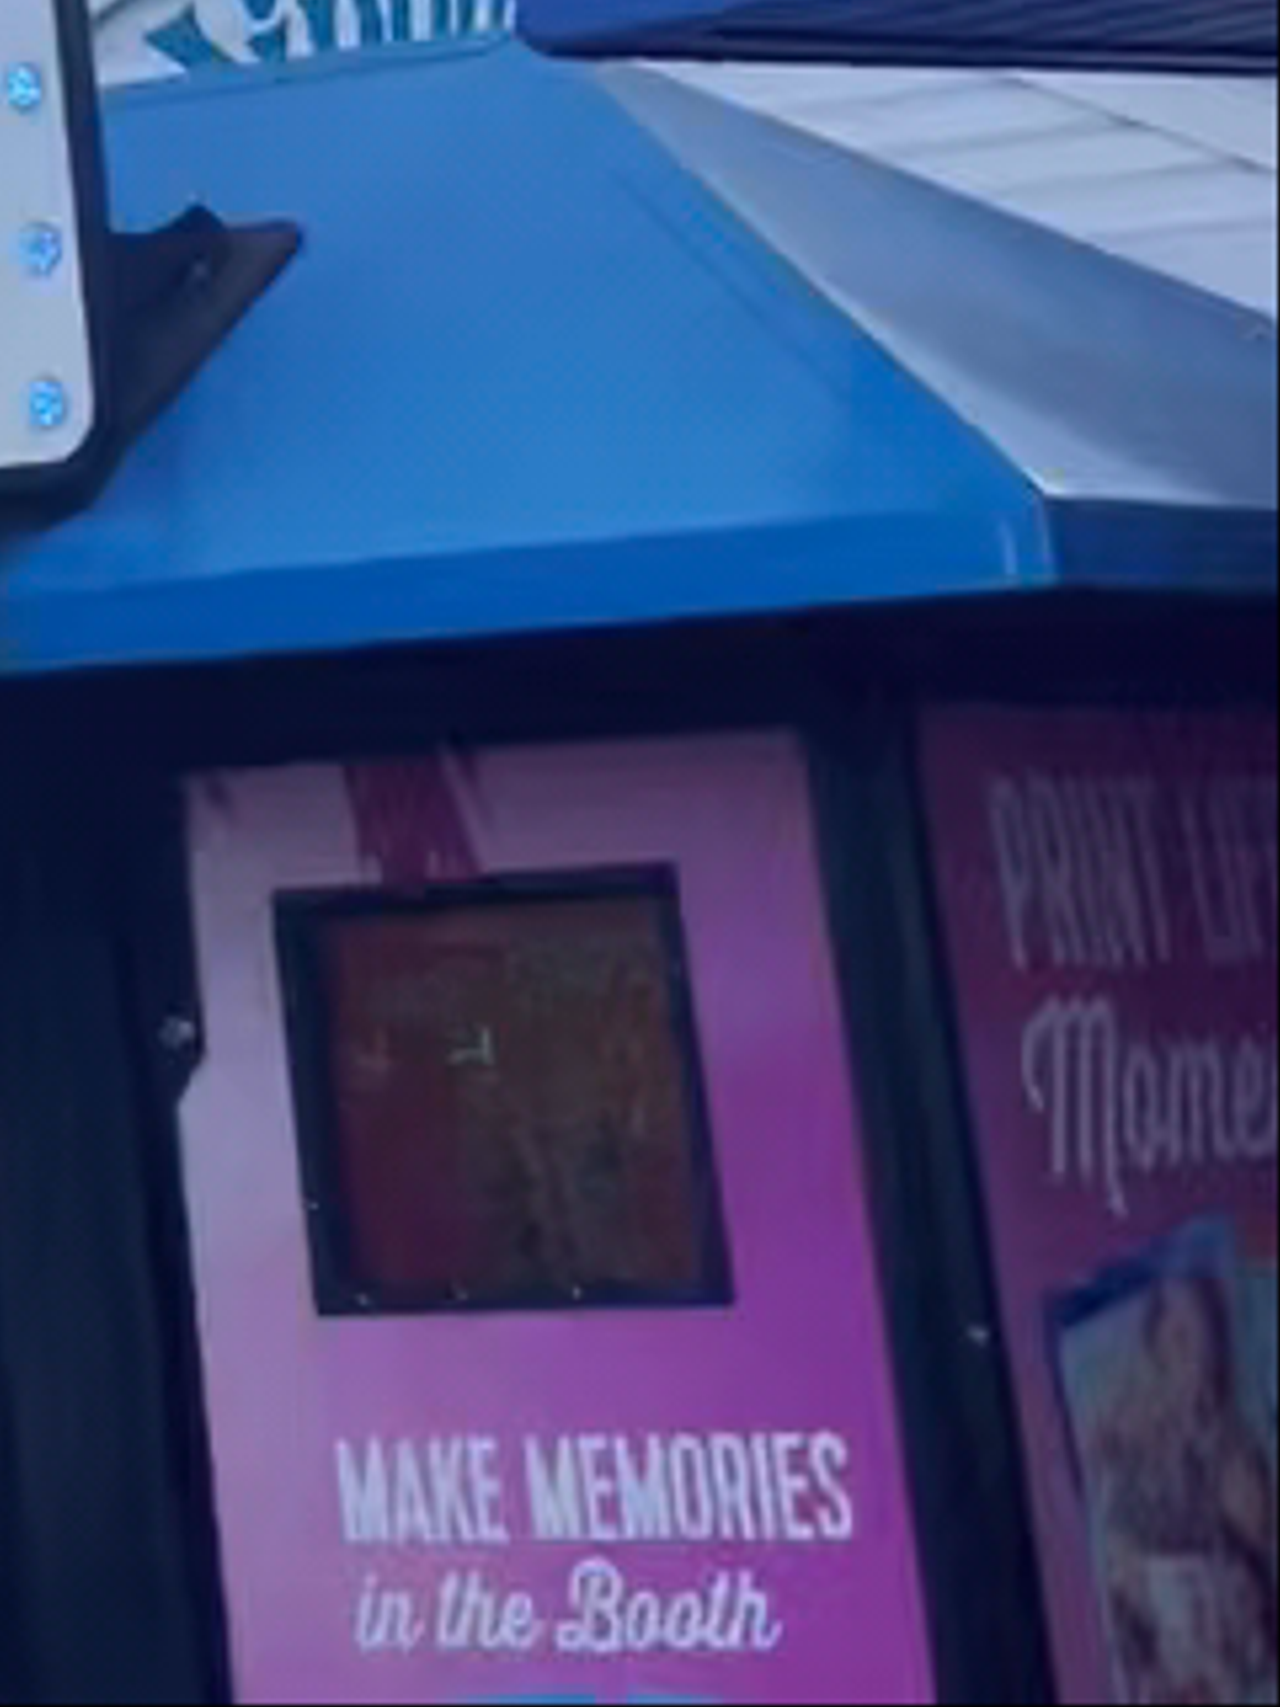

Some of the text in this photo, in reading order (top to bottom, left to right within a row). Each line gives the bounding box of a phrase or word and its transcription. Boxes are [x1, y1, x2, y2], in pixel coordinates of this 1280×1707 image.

[987, 772, 1172, 968] PRINT
[1021, 992, 1278, 1218] Mome
[336, 1429, 855, 1545] MAKE MEMORIES
[354, 1556, 782, 1653] in the Booth
